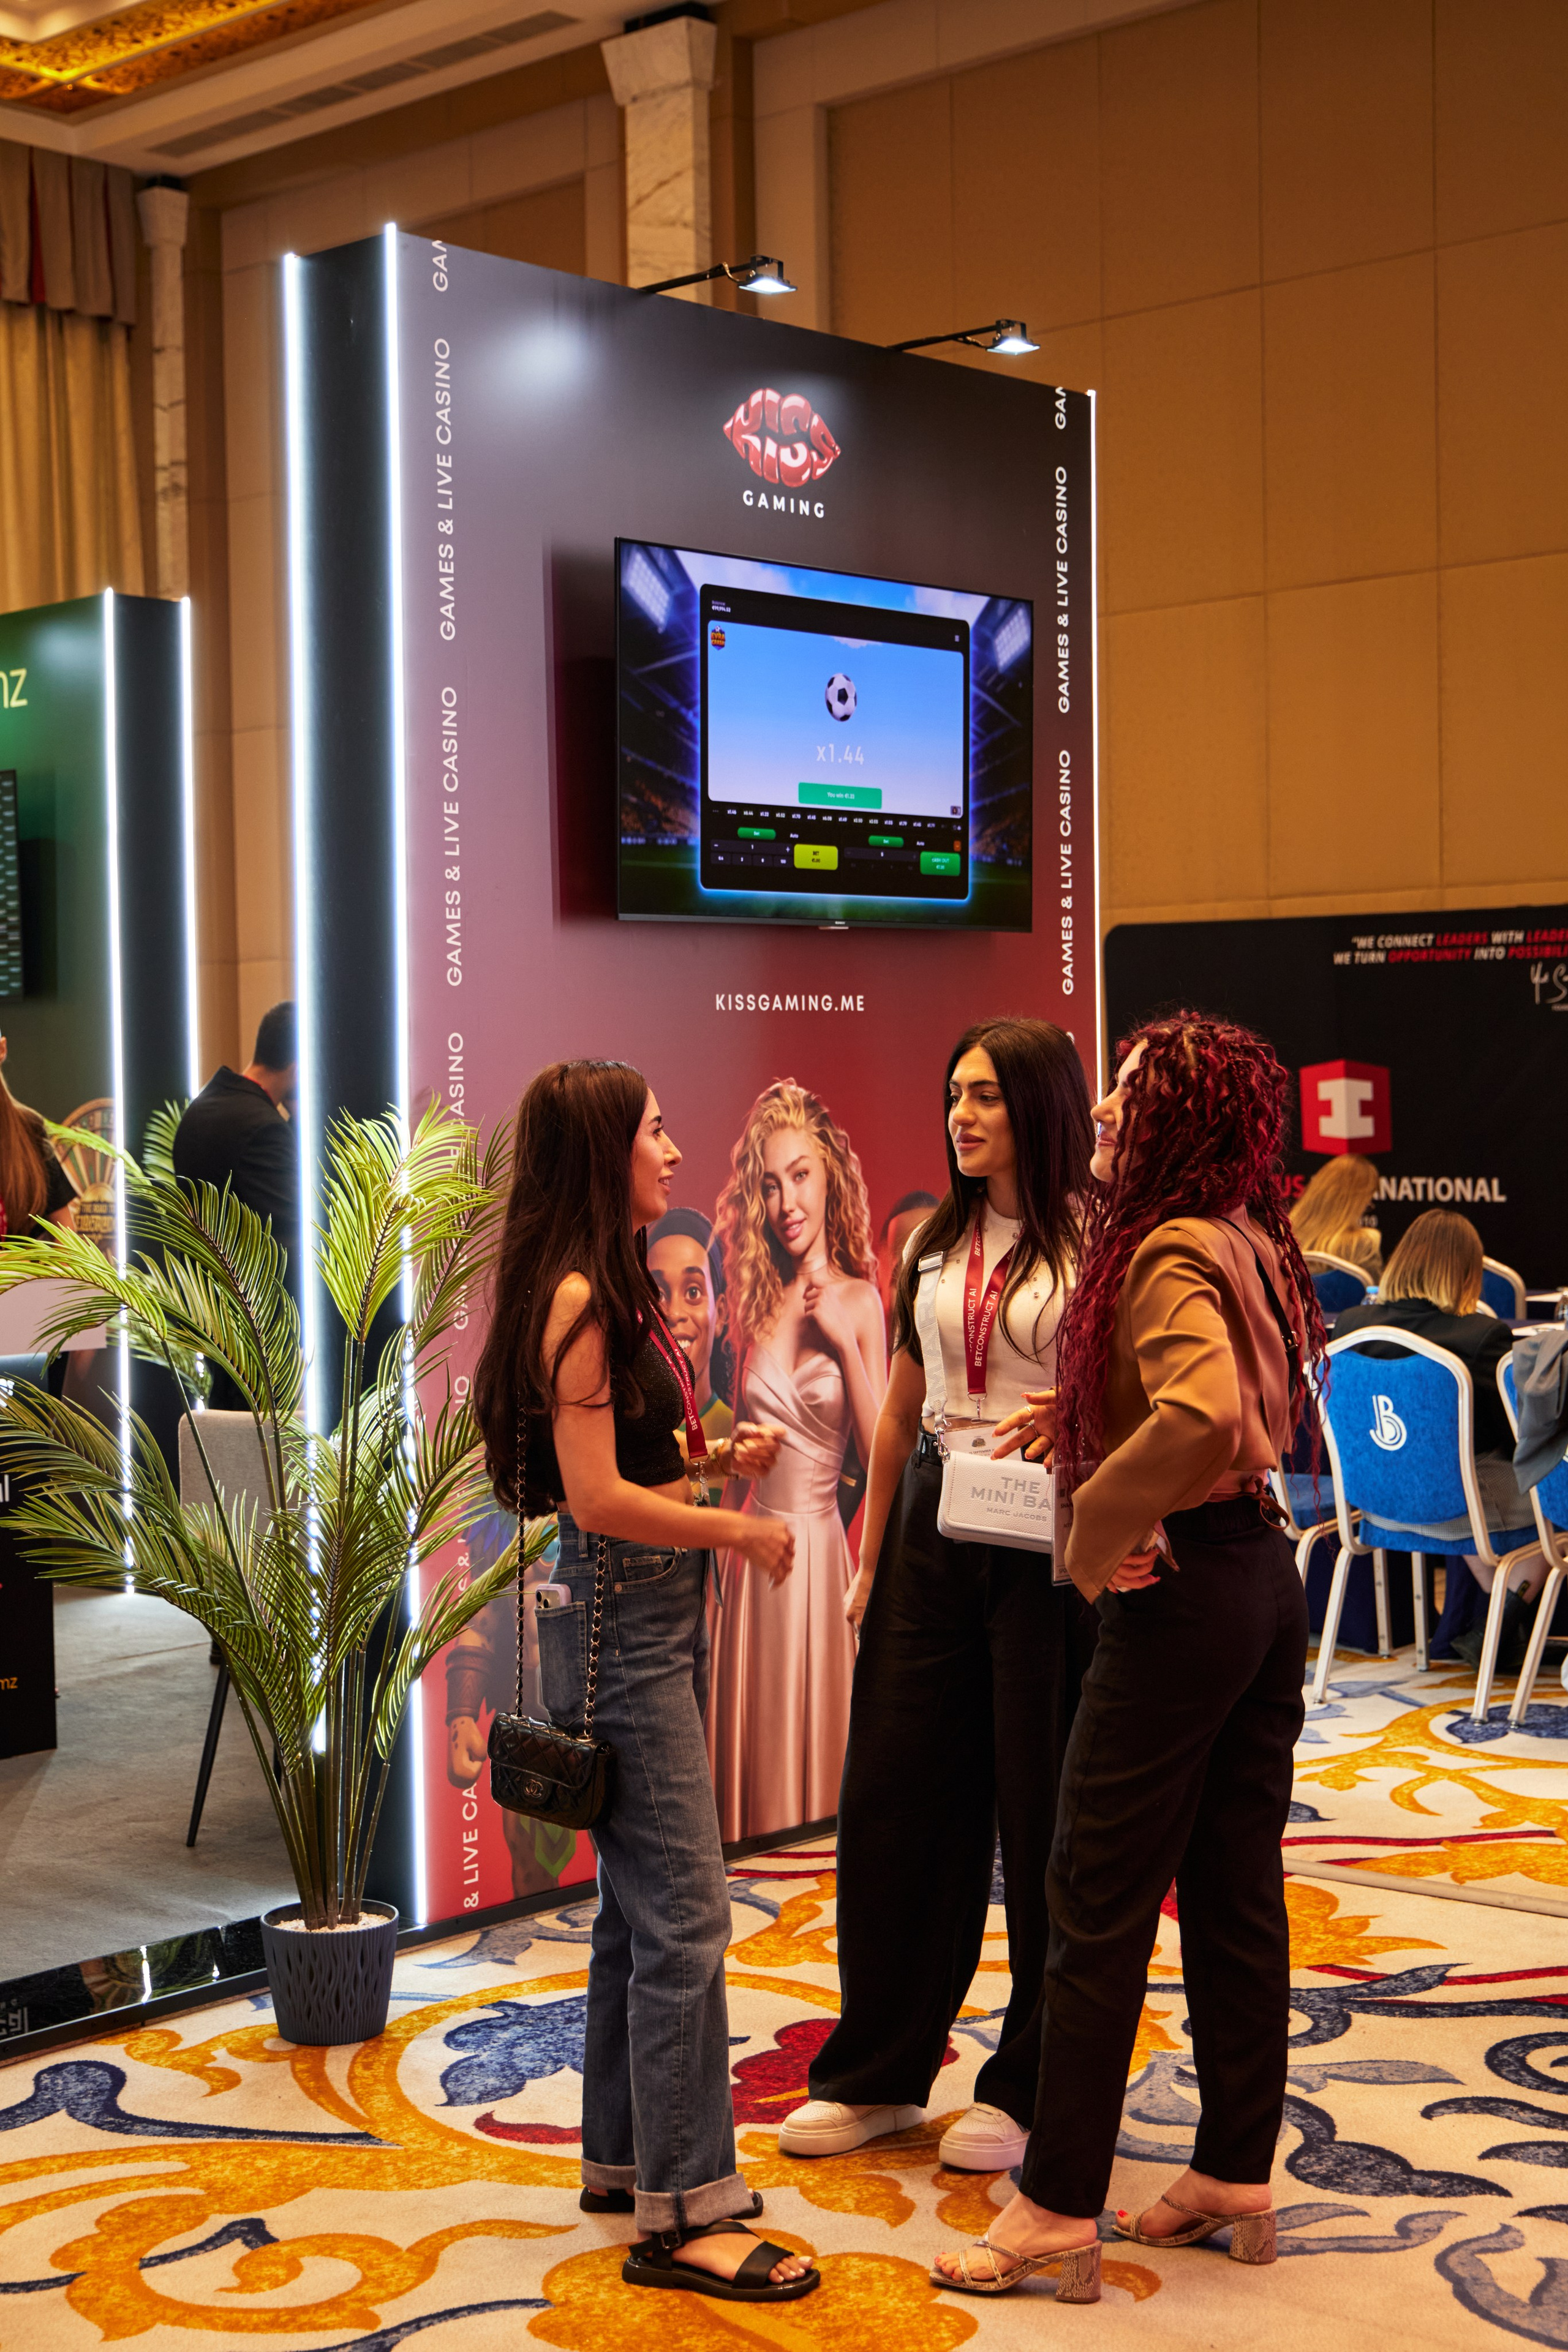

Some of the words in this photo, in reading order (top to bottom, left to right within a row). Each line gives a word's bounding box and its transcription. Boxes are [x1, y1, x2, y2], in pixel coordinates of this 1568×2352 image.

[434, 338, 451, 445] CASINO
[436, 453, 453, 510] LIVE
[742, 490, 824, 518] GAMING
[437, 519, 453, 535] &
[1055, 466, 1068, 554] CASINO
[438, 543, 456, 641] GAMES
[1057, 560, 1068, 606] LIVE
[1057, 614, 1069, 627] &
[1058, 633, 1070, 714] GAMES
[441, 687, 459, 792] CASINO
[1059, 750, 1071, 837] CASINO
[443, 801, 460, 856] LIVE
[445, 865, 461, 881] &
[1060, 843, 1072, 889] LIVE
[1061, 896, 1072, 909] &
[445, 891, 462, 986] GAMES
[1061, 916, 1074, 995] GAMES
[1333, 951, 1352, 965] WE
[1354, 950, 1387, 964] TURN
[1474, 946, 1506, 960] INTO
[1377, 933, 1434, 949] CONNECT
[1491, 929, 1525, 944] WITH
[715, 993, 864, 1011] KISSGAMING.ME
[974, 1300, 994, 1366] BETCONSTRUCT
[989, 1290, 998, 1300] AI
[971, 1487, 1016, 1506] MINI
[1022, 1495, 1052, 1512] BA
[1001, 1476, 1041, 1494] THE
[986, 1507, 1011, 1517] MARC
[1013, 1512, 1047, 1523] JACOBS
[462, 1828, 479, 1885] LIVE
[463, 1891, 479, 1908] &
